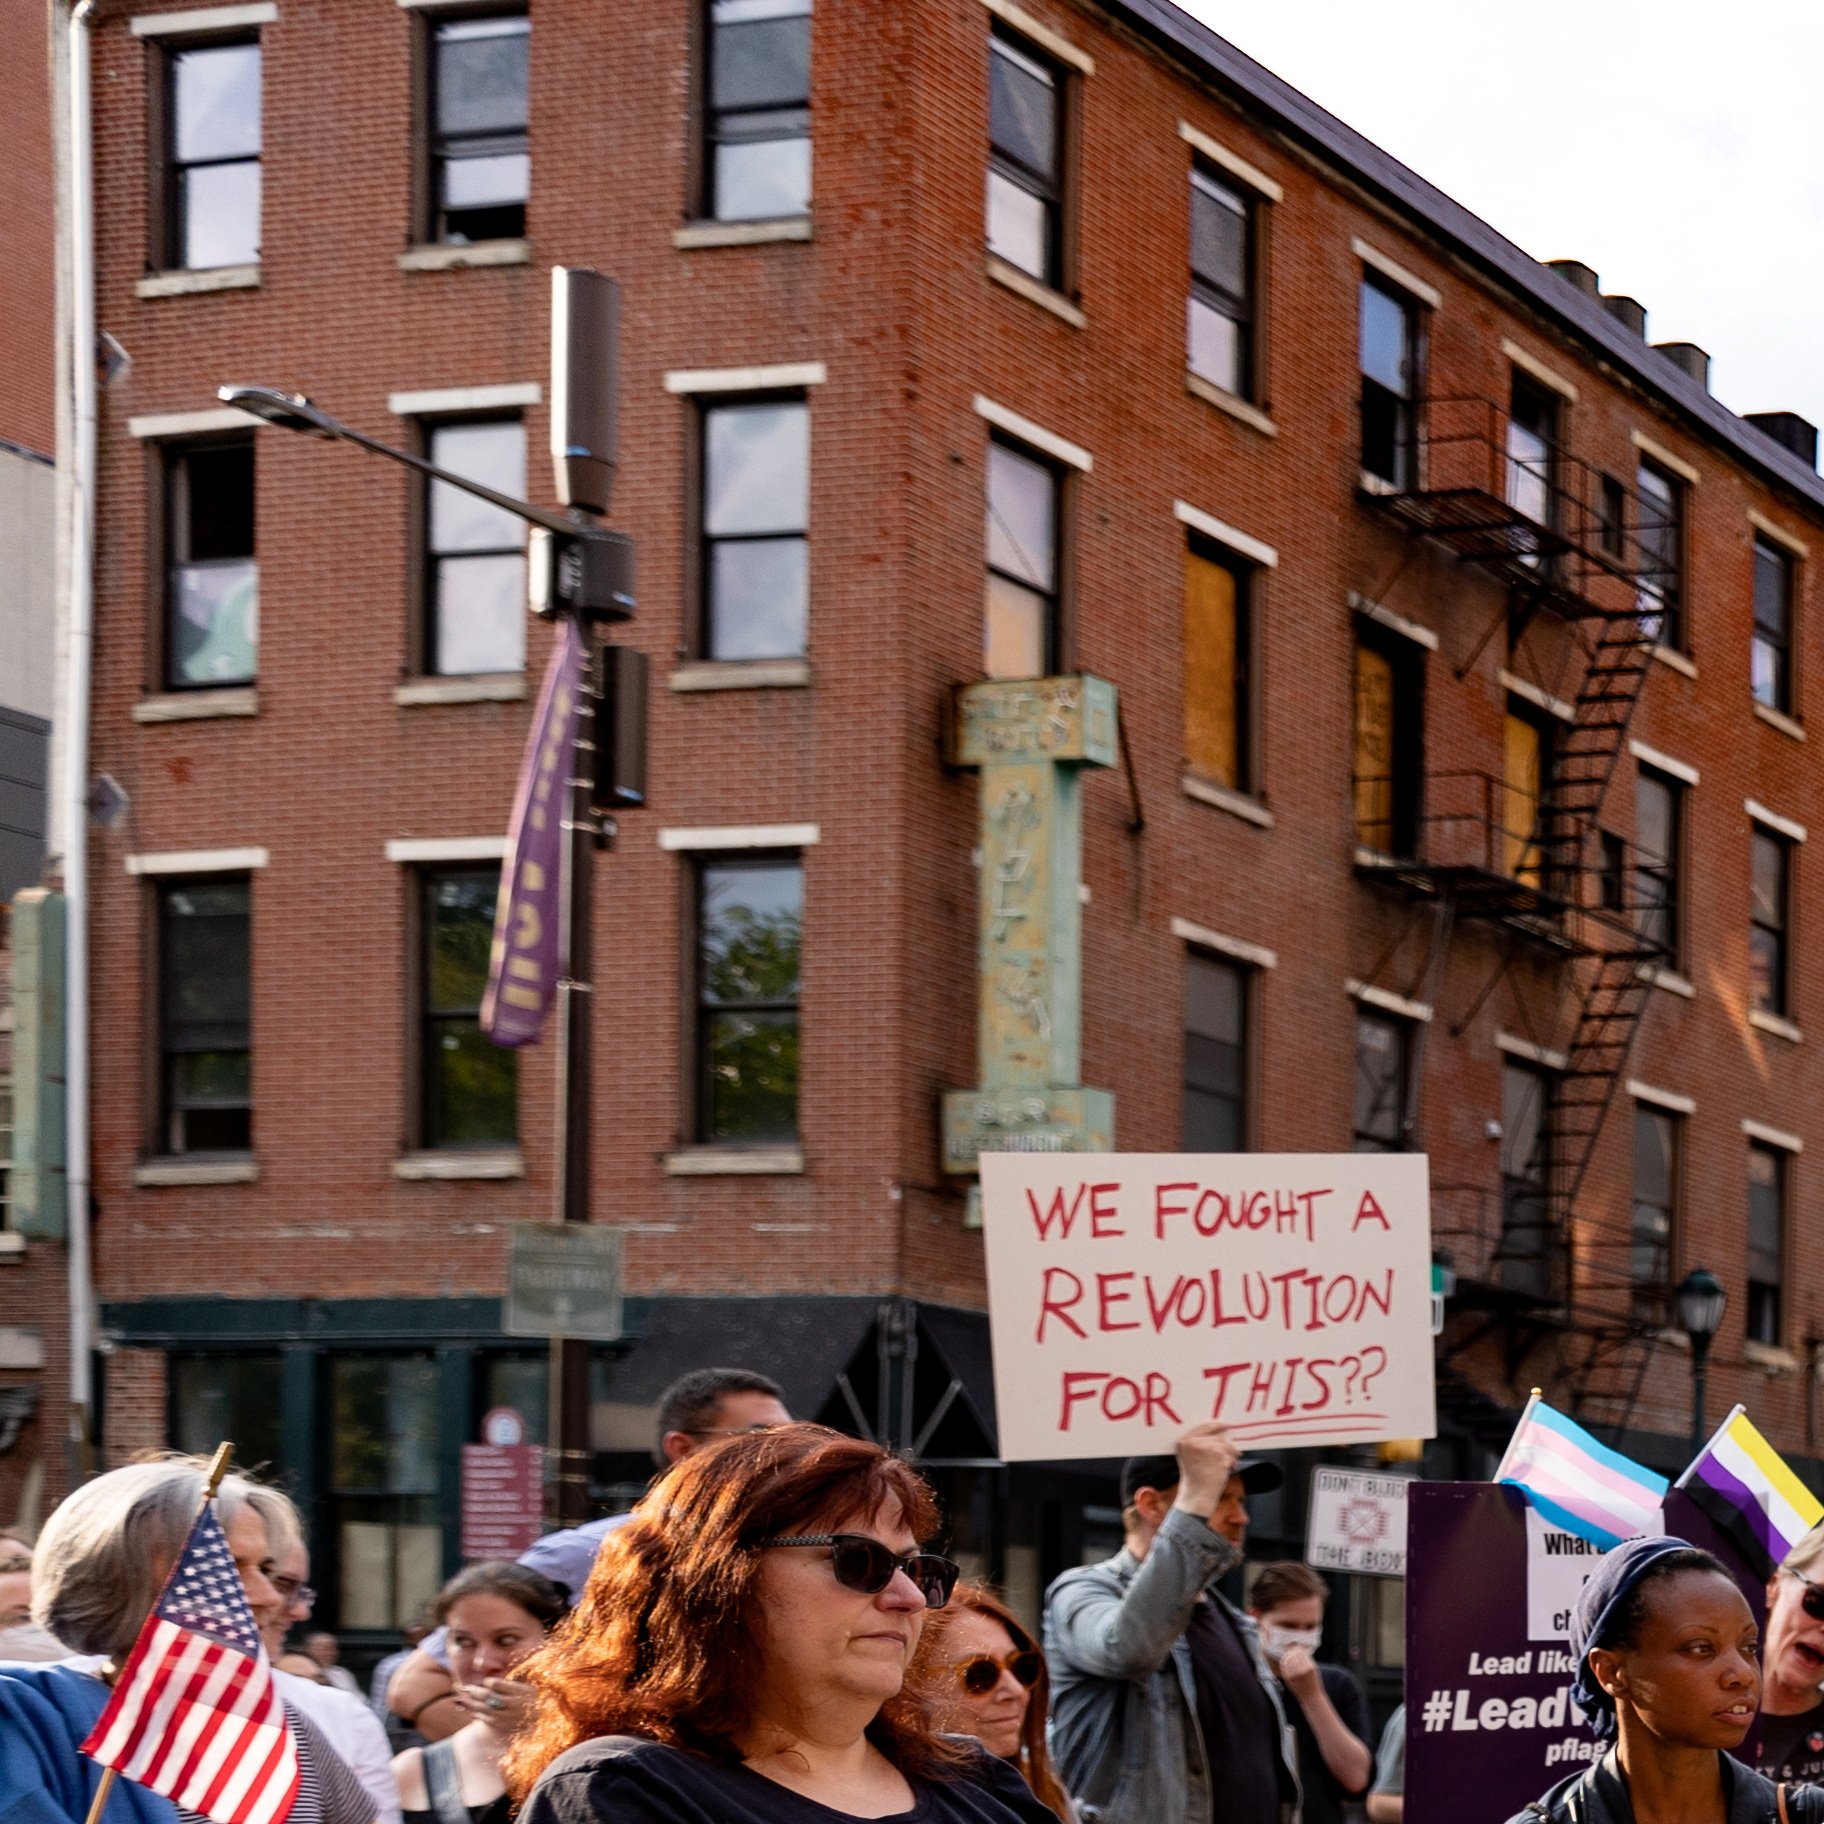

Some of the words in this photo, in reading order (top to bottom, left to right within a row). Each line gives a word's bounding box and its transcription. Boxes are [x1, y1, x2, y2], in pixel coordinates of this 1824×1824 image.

[1026, 1182, 1126, 1242] WE
[1155, 1182, 1335, 1242] FOUGHT
[1352, 1189, 1392, 1232] A
[1035, 1267, 1395, 1345] REVOLUTION
[1057, 1370, 1183, 1432] FOR
[1203, 1345, 1388, 1420] THIS??
[1315, 1545, 1353, 1569] THE
[1468, 1650, 1534, 1676] Lead
